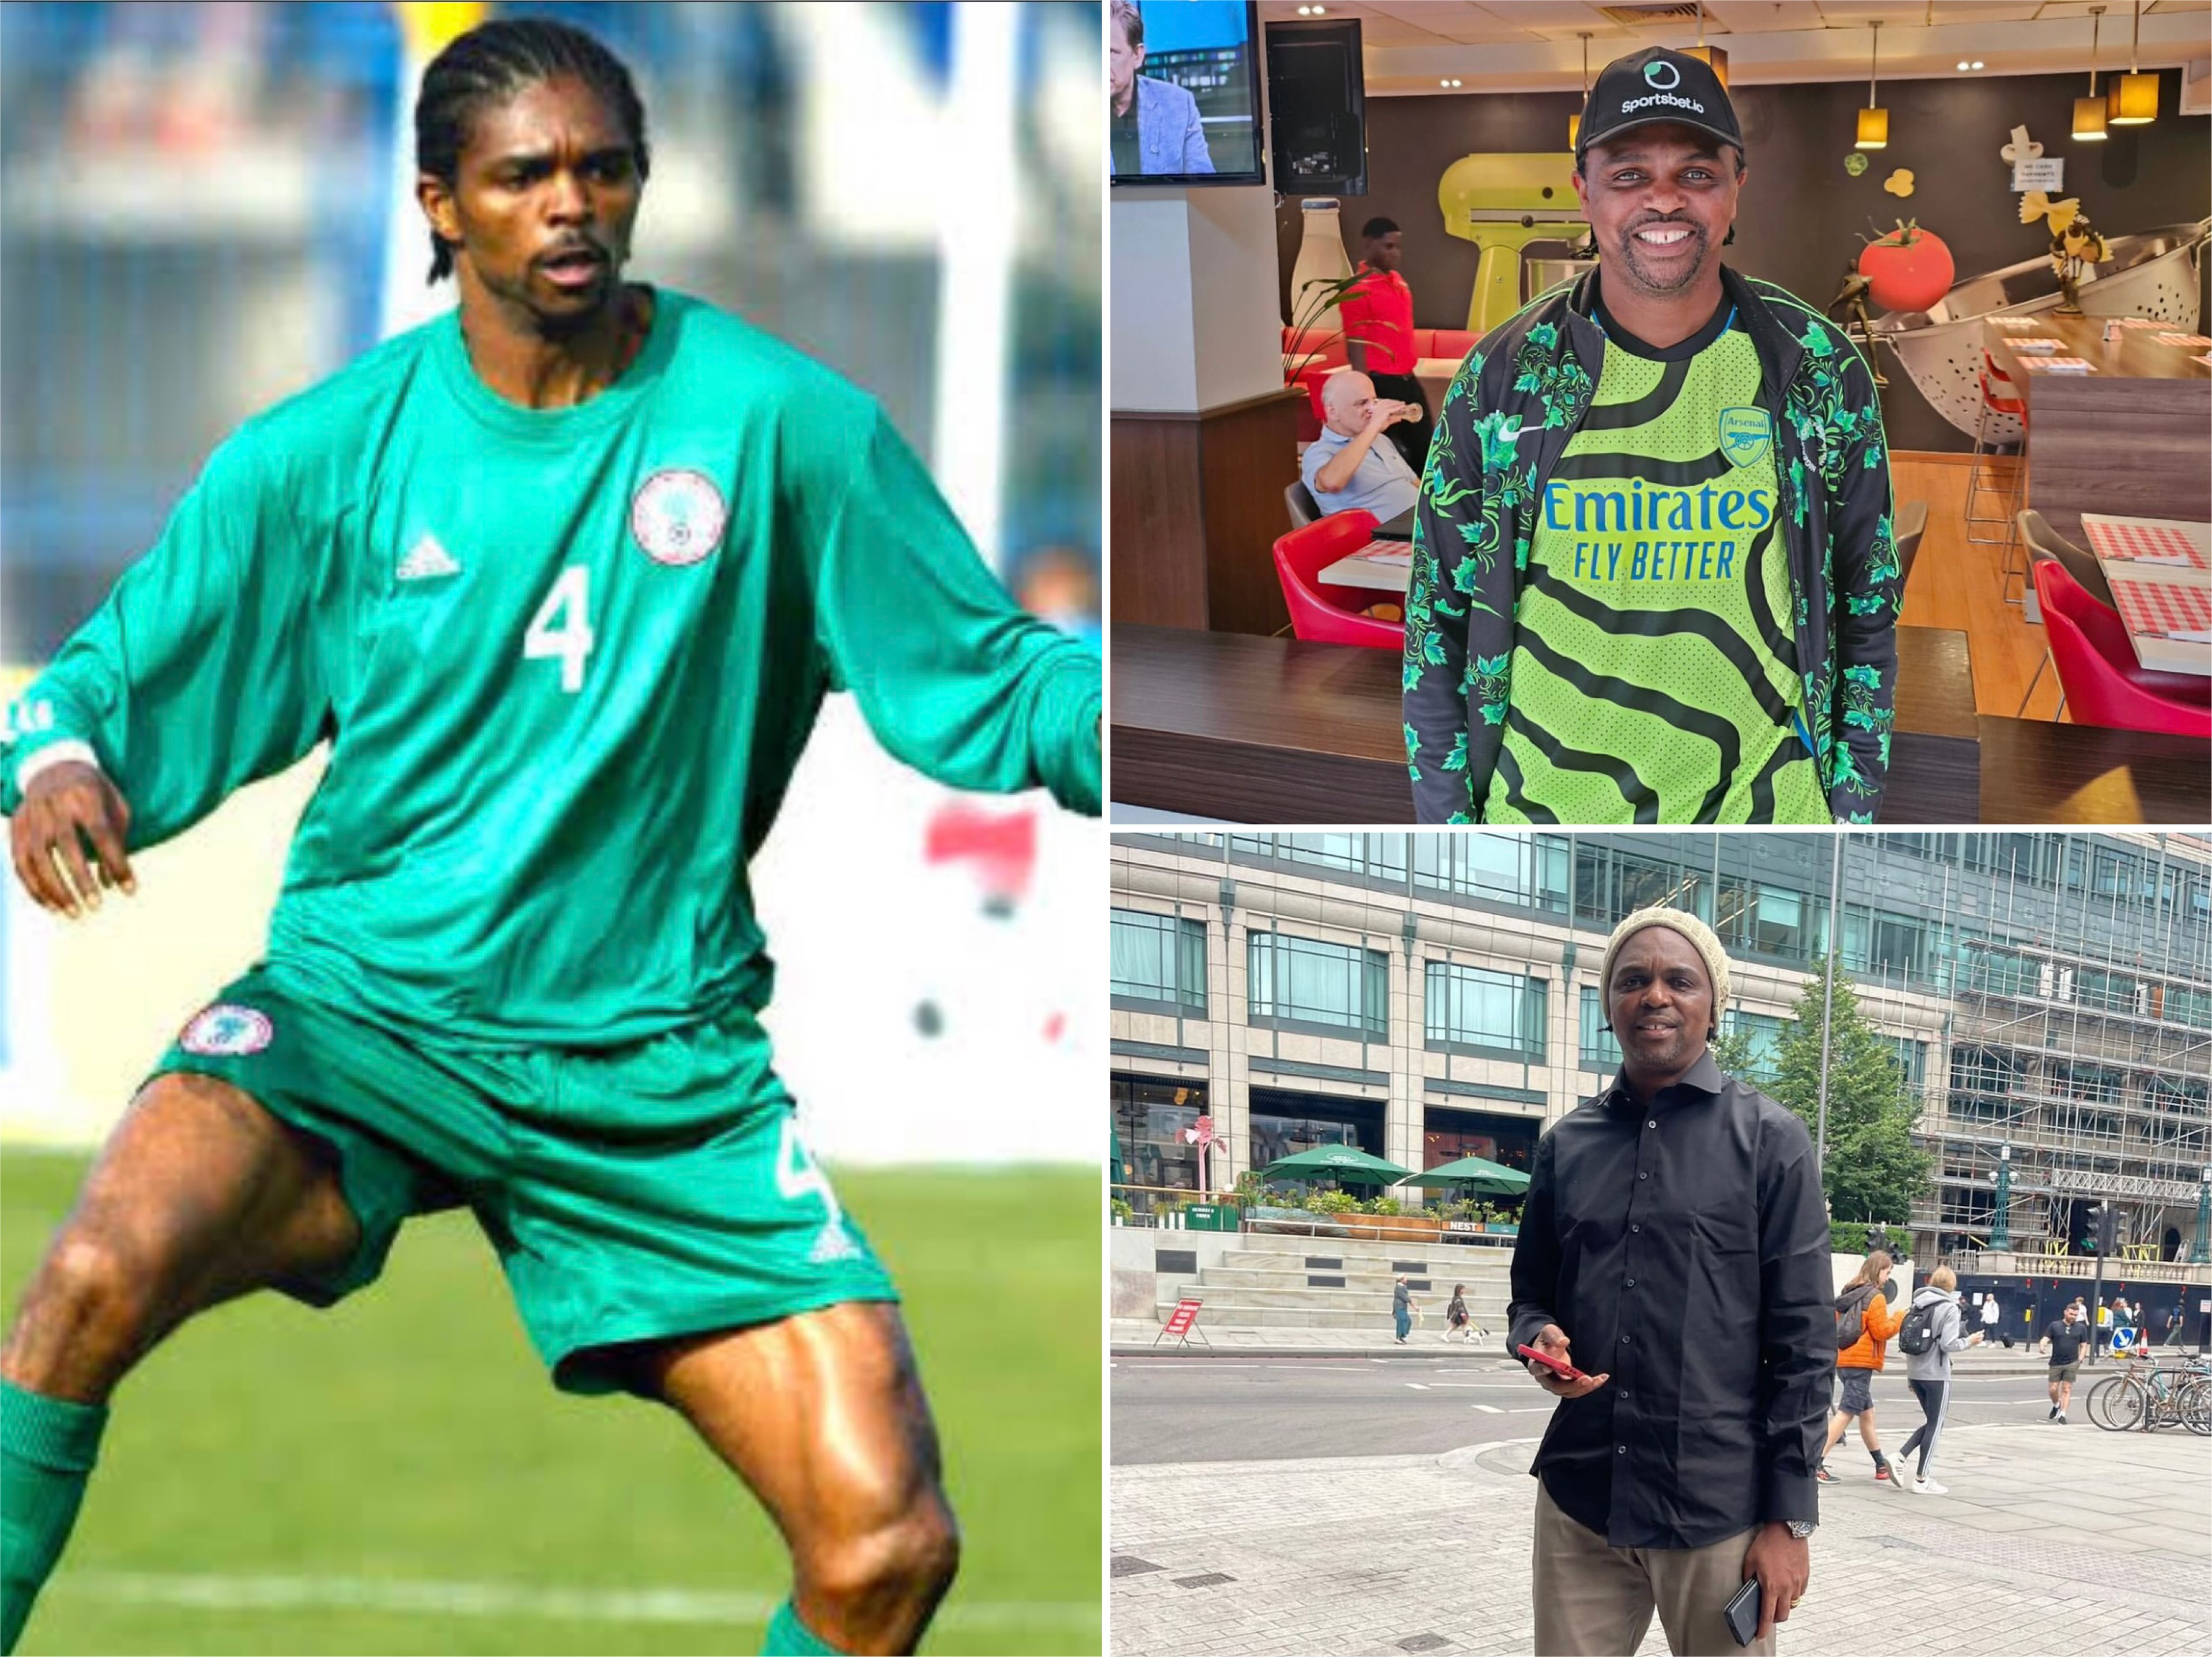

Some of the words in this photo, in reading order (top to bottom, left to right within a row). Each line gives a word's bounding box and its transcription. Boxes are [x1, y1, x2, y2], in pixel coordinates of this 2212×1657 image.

[1622, 93, 1705, 114] Sportsbet.io
[1728, 417, 1764, 428] Arsenal
[1545, 481, 1770, 531] Emirates
[1574, 543, 1622, 580] FLY
[1631, 541, 1736, 580] BETTER
[524, 563, 594, 693] 4
[777, 1117, 843, 1224] 4
[1450, 1221, 1477, 1231] NEST
